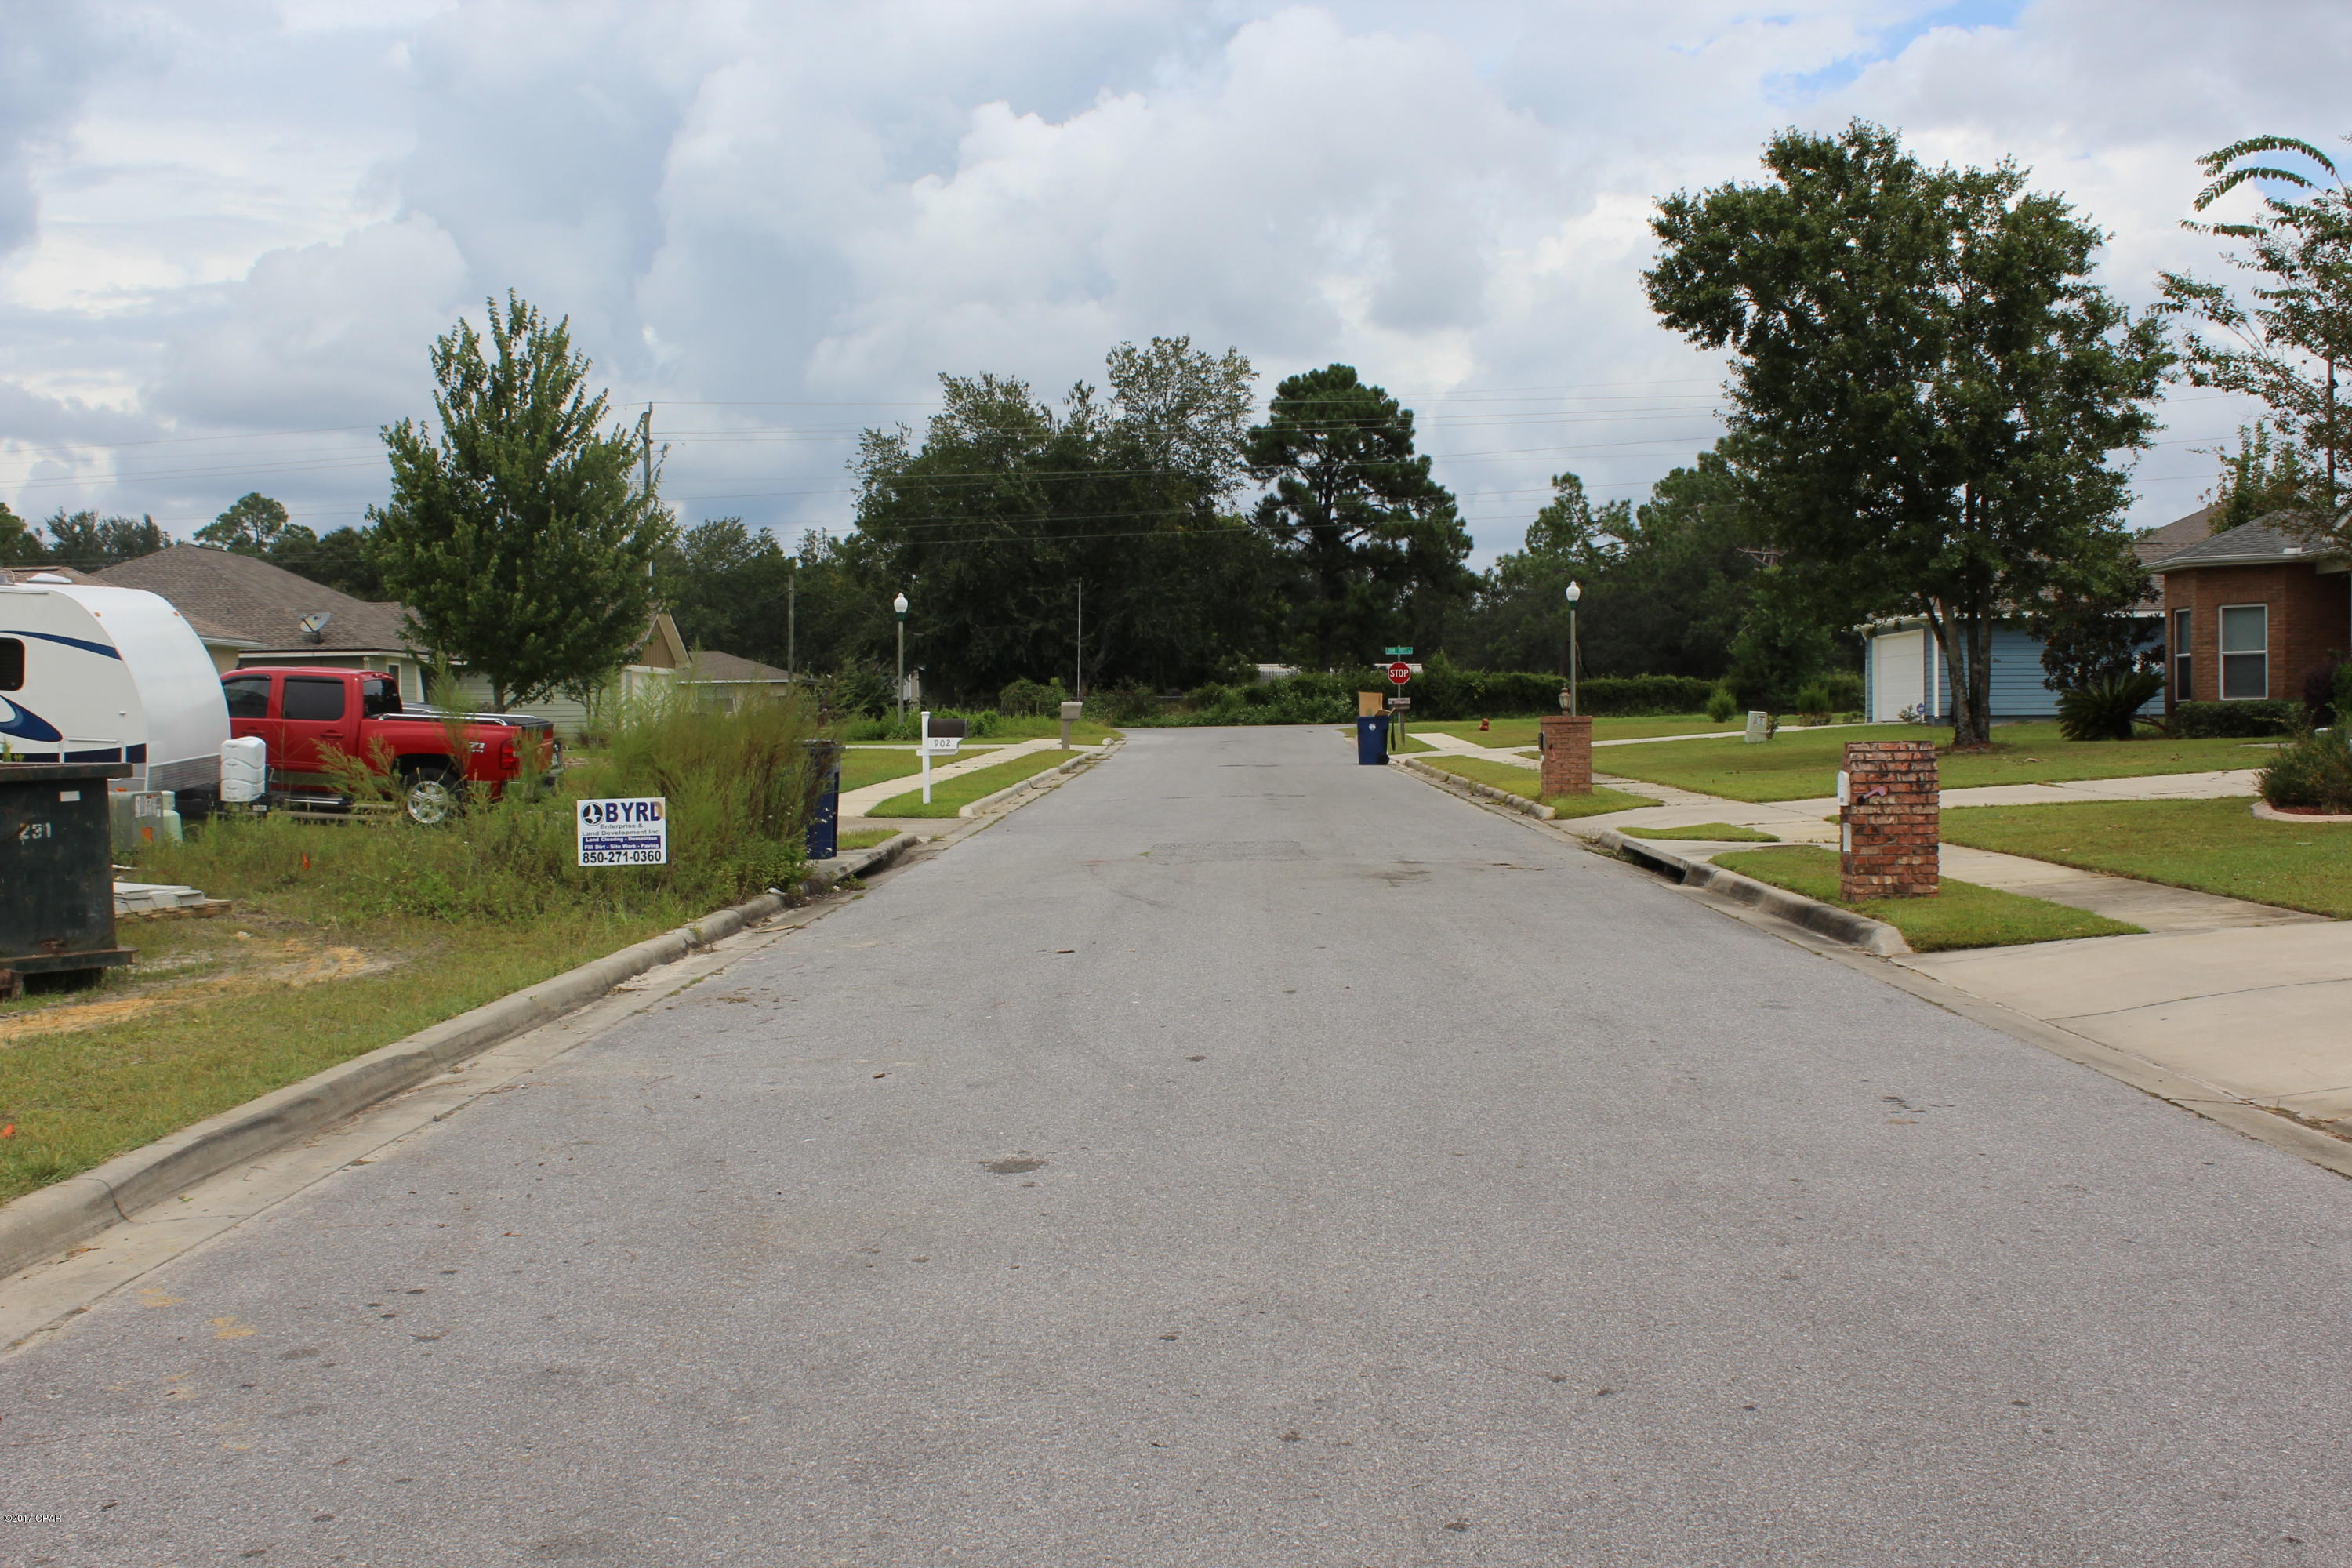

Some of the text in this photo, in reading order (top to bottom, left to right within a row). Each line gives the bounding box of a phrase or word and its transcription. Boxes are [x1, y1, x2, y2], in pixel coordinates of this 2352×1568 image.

[1390, 669, 1409, 677] STOP
[605, 802, 663, 822] BYRD
[19, 823, 51, 839] 231
[583, 851, 661, 863] 850-271-0360
